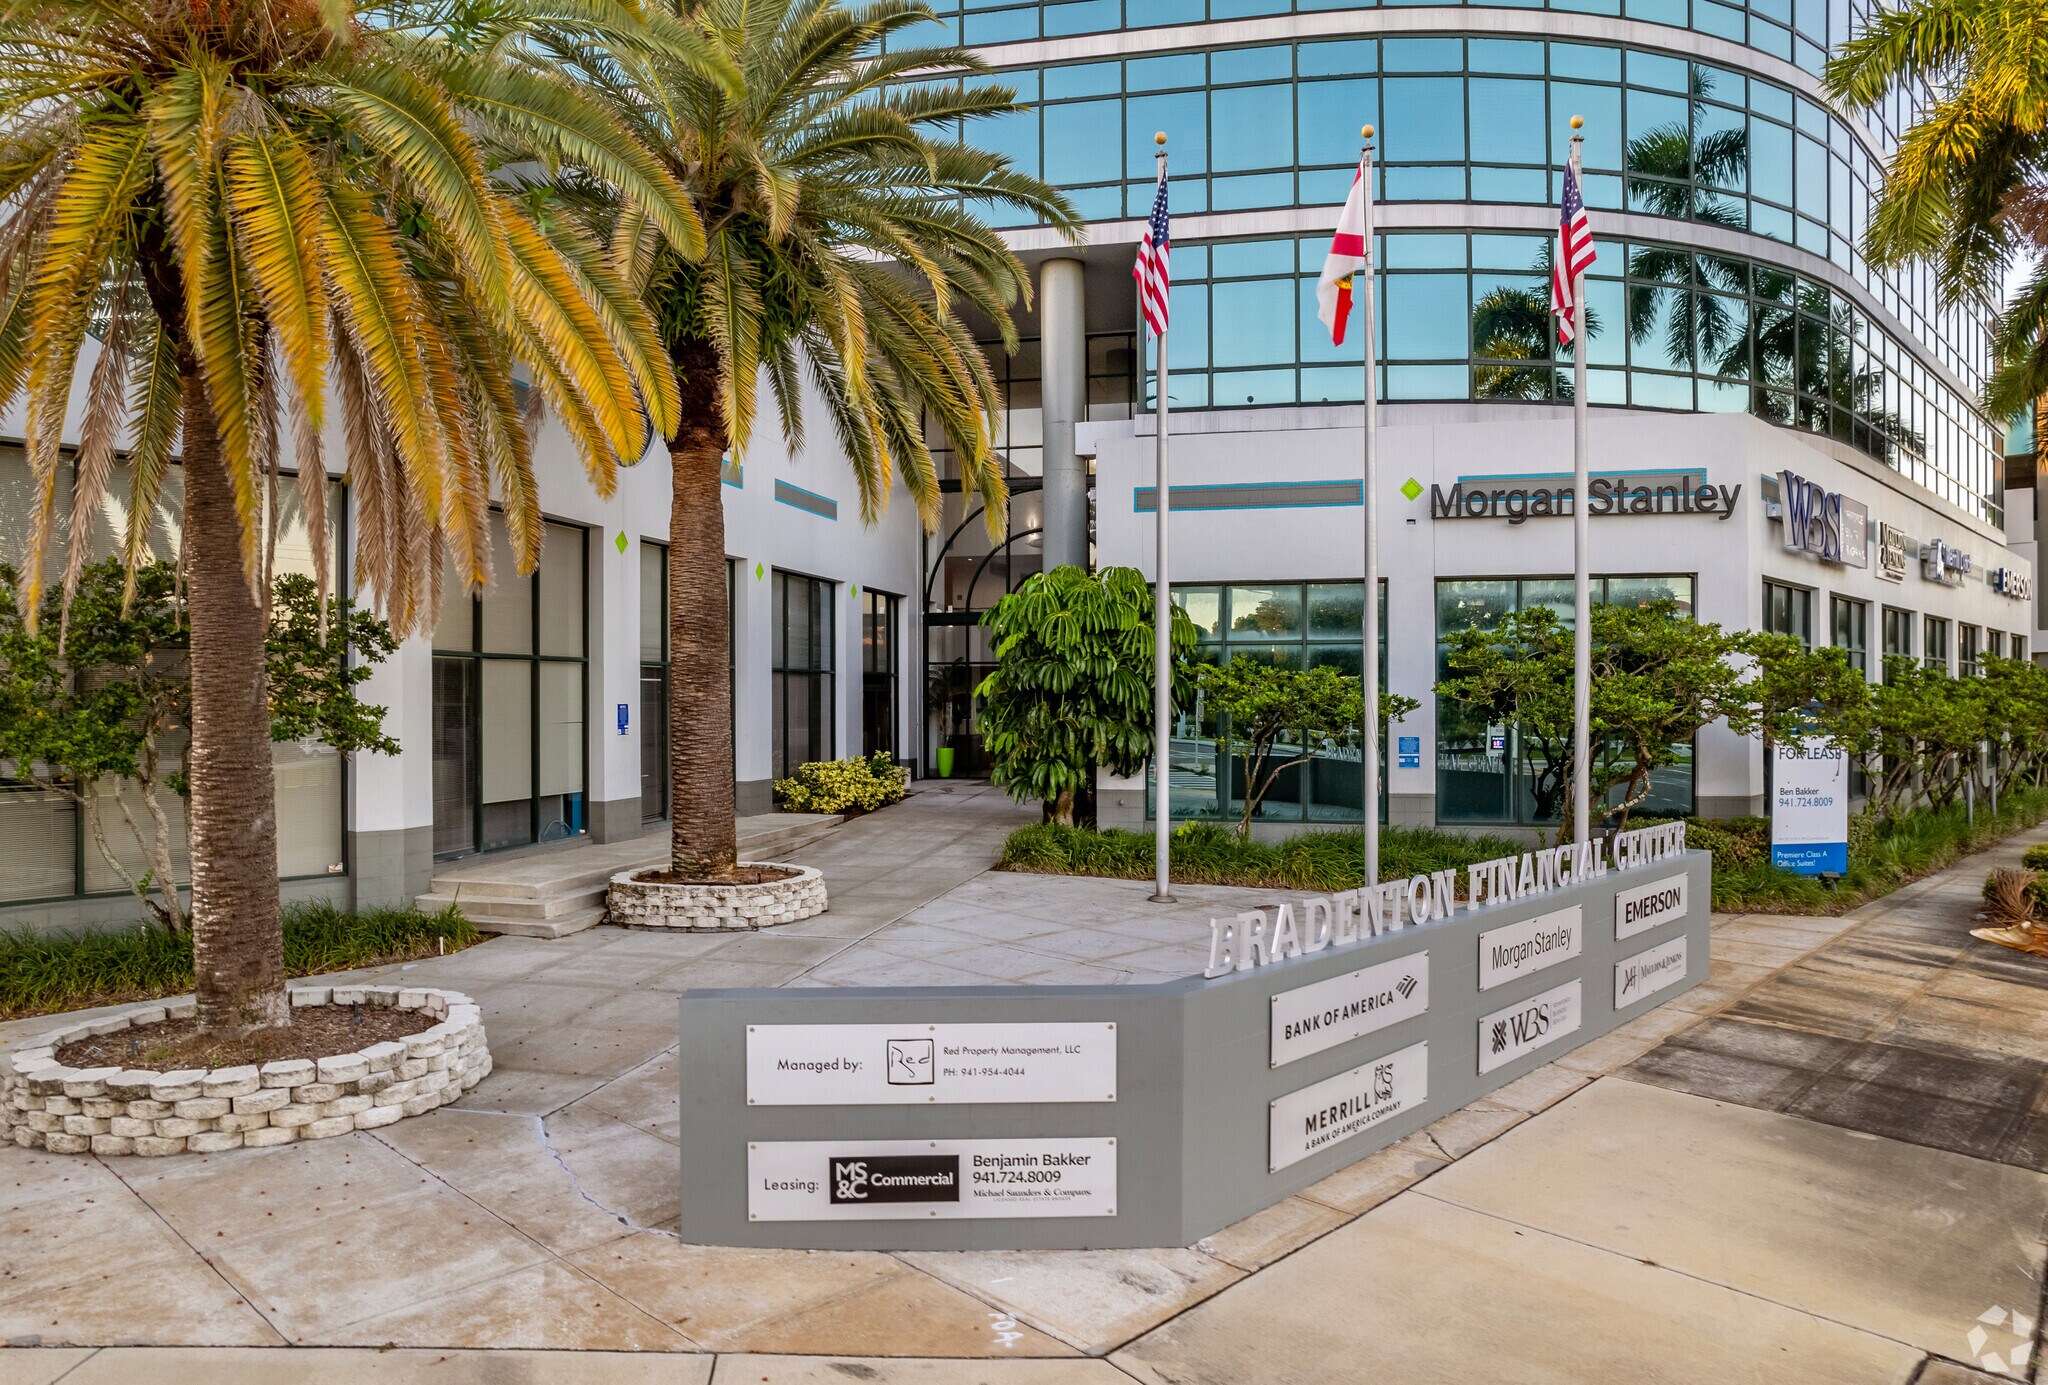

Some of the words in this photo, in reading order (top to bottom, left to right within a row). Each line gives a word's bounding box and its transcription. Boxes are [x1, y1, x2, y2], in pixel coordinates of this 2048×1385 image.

[1431, 482, 1575, 525] Morgan
[1588, 476, 1742, 520] Stanley
[1776, 470, 1841, 561] WBS
[2000, 568, 2032, 600] EMERSON
[1779, 747, 1804, 760] FOR
[1807, 747, 1842, 760] LEASE
[1780, 787, 1794, 796] Ben
[1796, 787, 1819, 796] Bakker
[1778, 797, 1834, 807] 941.724.8009
[1777, 851, 1805, 859] Premiere
[1806, 850, 1821, 858] Class
[1204, 868, 1457, 980] BRADENTON
[1467, 837, 1607, 911] FINANCIAL
[1613, 821, 1686, 871] CENTER
[1625, 887, 1681, 924] EMERSON
[1493, 940, 1533, 970] Morgan
[1534, 925, 1572, 955] Stanley
[1285, 1014, 1321, 1040] BANK
[1323, 1008, 1339, 1026] OF
[1342, 990, 1394, 1020] AMERICA
[1509, 1003, 1550, 1047] WBS
[943, 1046, 960, 1055] Red
[963, 1046, 998, 1057] Property
[1001, 1045, 1062, 1056] Management,
[1065, 1045, 1081, 1054] LLC
[776, 1058, 839, 1073] Managed
[843, 1058, 863, 1073] by:
[891, 1045, 930, 1079] Red
[943, 1068, 958, 1077] PH:
[961, 1067, 1025, 1077] 941-954-4044
[1305, 1092, 1371, 1135] MERRILL
[1305, 1142, 1311, 1151] A
[1311, 1133, 1330, 1148] BANK
[1331, 1128, 1341, 1140] OF
[1342, 1115, 1371, 1134] AMERICA
[1371, 1100, 1402, 1121] COMPANY
[973, 1153, 1038, 1170] Benjamin
[1042, 1153, 1091, 1166] Bakker
[835, 1162, 868, 1181] MS
[870, 1172, 954, 1187] Commercial
[972, 1170, 1061, 1183] 941.724.8009
[764, 1178, 819, 1193] Leasing:
[836, 1180, 868, 1199] &C
[973, 1189, 1005, 1198] Michael
[1007, 1188, 1041, 1196] Saunders
[1044, 1188, 1051, 1196] &
